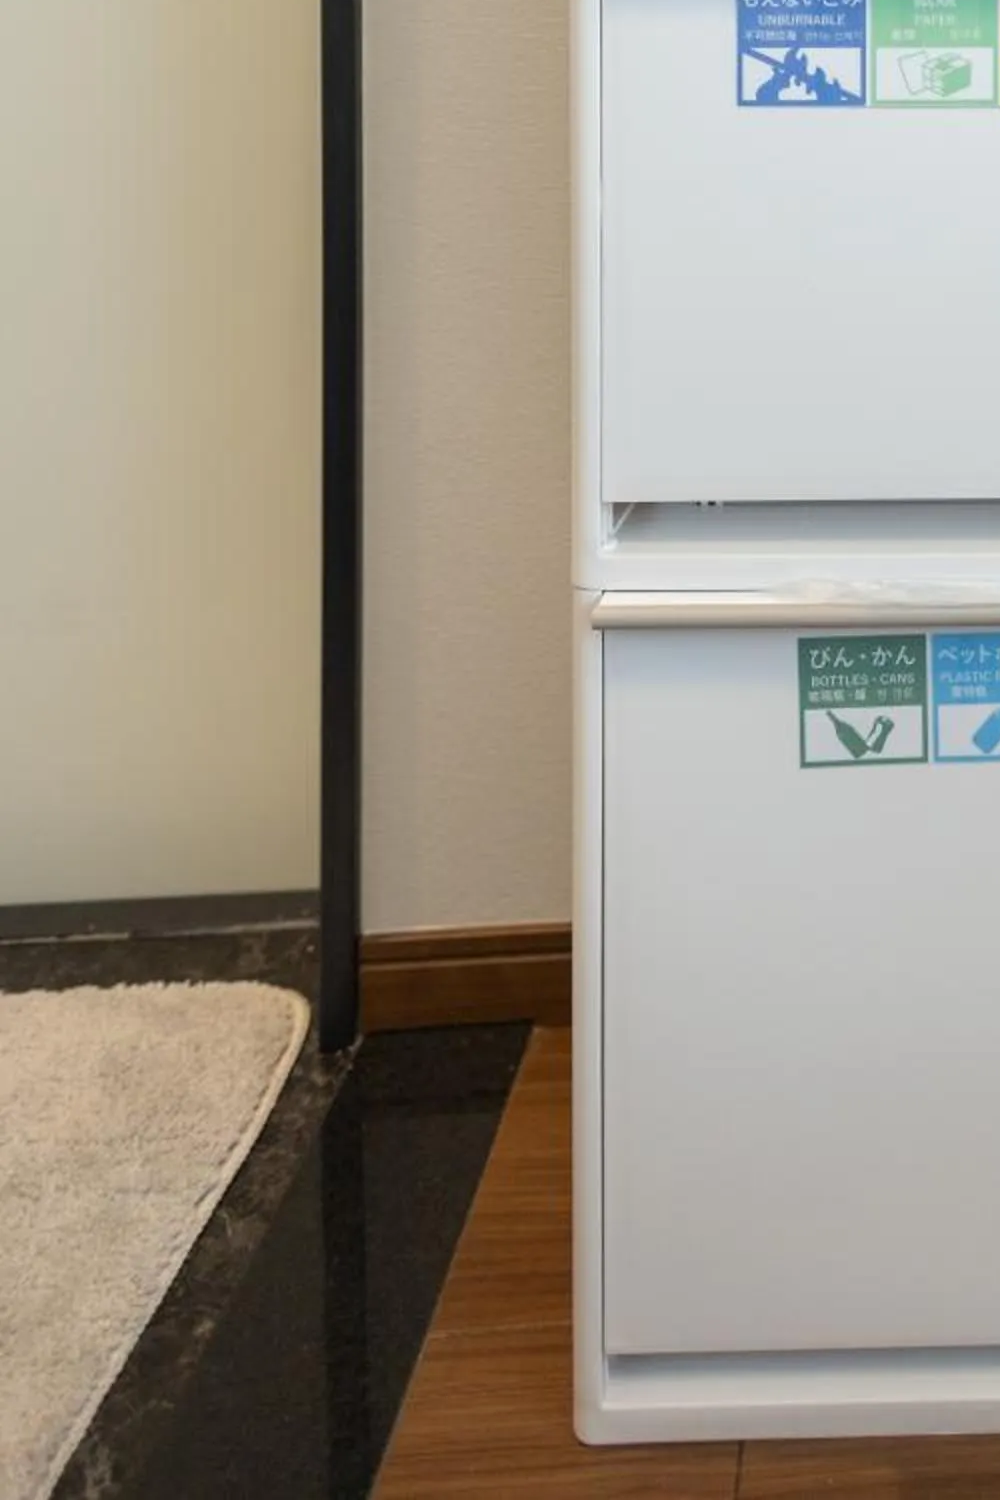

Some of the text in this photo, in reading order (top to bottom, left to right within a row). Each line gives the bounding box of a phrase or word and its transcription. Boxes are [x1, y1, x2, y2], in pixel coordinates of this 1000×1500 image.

[757, 13, 846, 26] UNBURNABLE
[809, 645, 916, 669] びん・かん
[940, 670, 993, 684] PLASTIC
